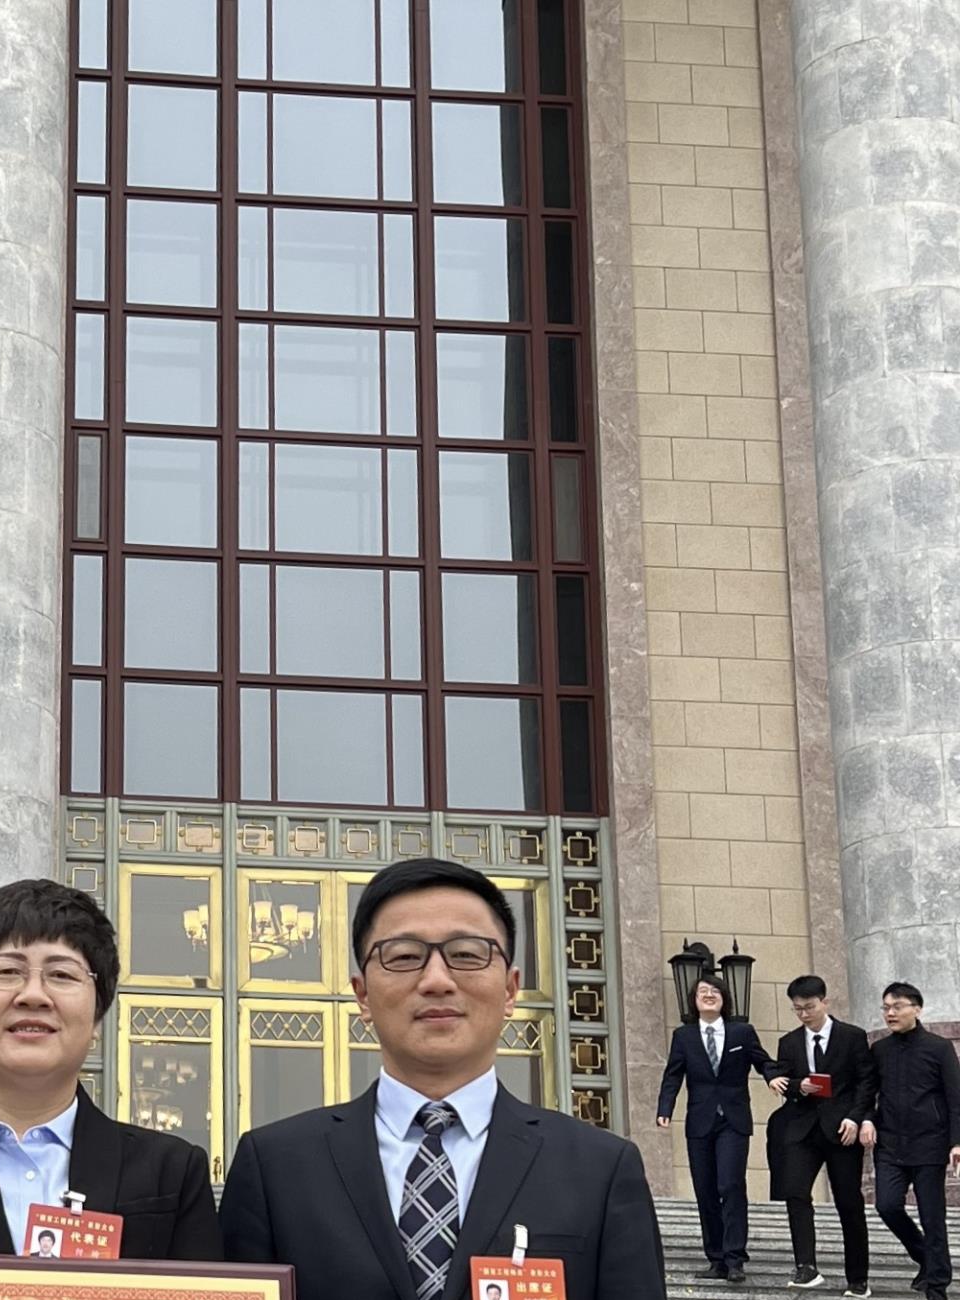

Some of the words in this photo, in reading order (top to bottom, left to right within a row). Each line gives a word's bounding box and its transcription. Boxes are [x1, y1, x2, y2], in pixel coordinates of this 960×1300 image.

[70, 1231, 108, 1247] 代表证
[515, 1281, 552, 1293] 出席证
